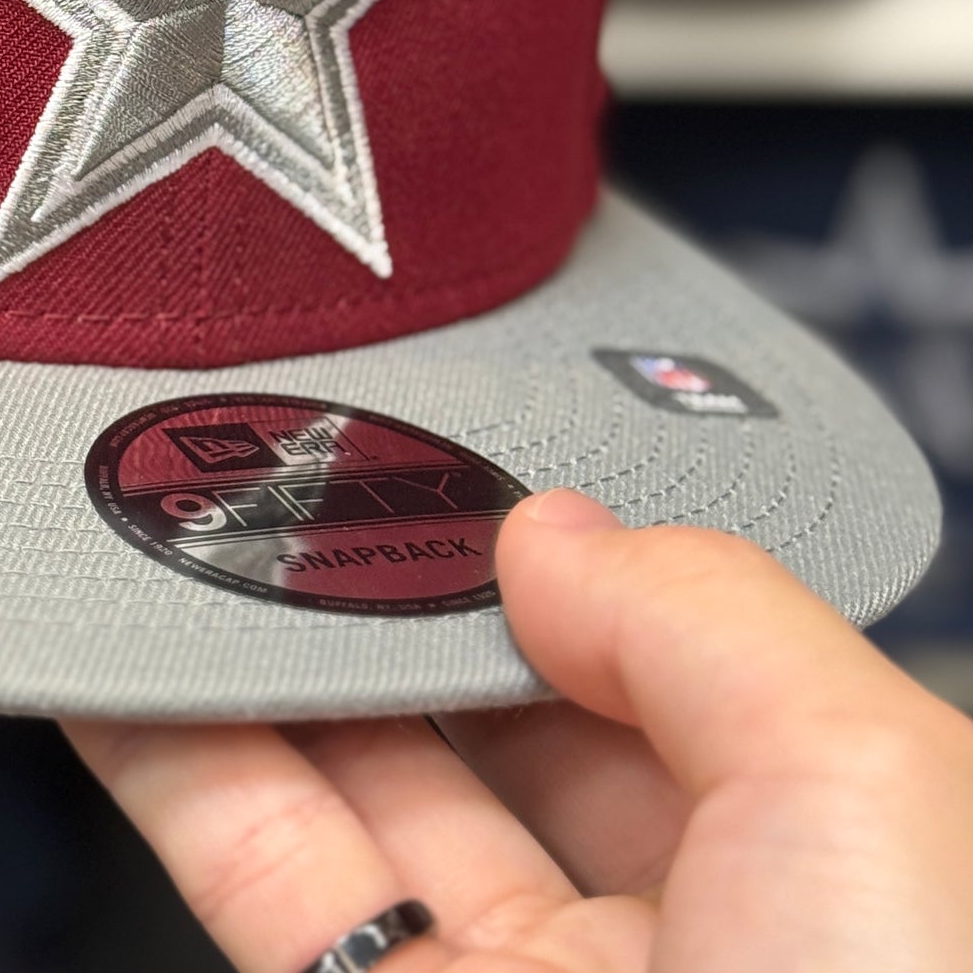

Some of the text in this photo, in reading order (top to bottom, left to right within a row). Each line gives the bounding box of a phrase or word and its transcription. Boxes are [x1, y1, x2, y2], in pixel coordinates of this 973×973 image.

[268, 426, 334, 443] NEW
[280, 440, 347, 456] ERA
[160, 473, 458, 532] 9FIFTY
[127, 524, 153, 541] SINCE
[149, 541, 173, 556] 1920
[277, 537, 483, 573] SNAPBACK
[178, 557, 268, 594] NEWERACAP.COM
